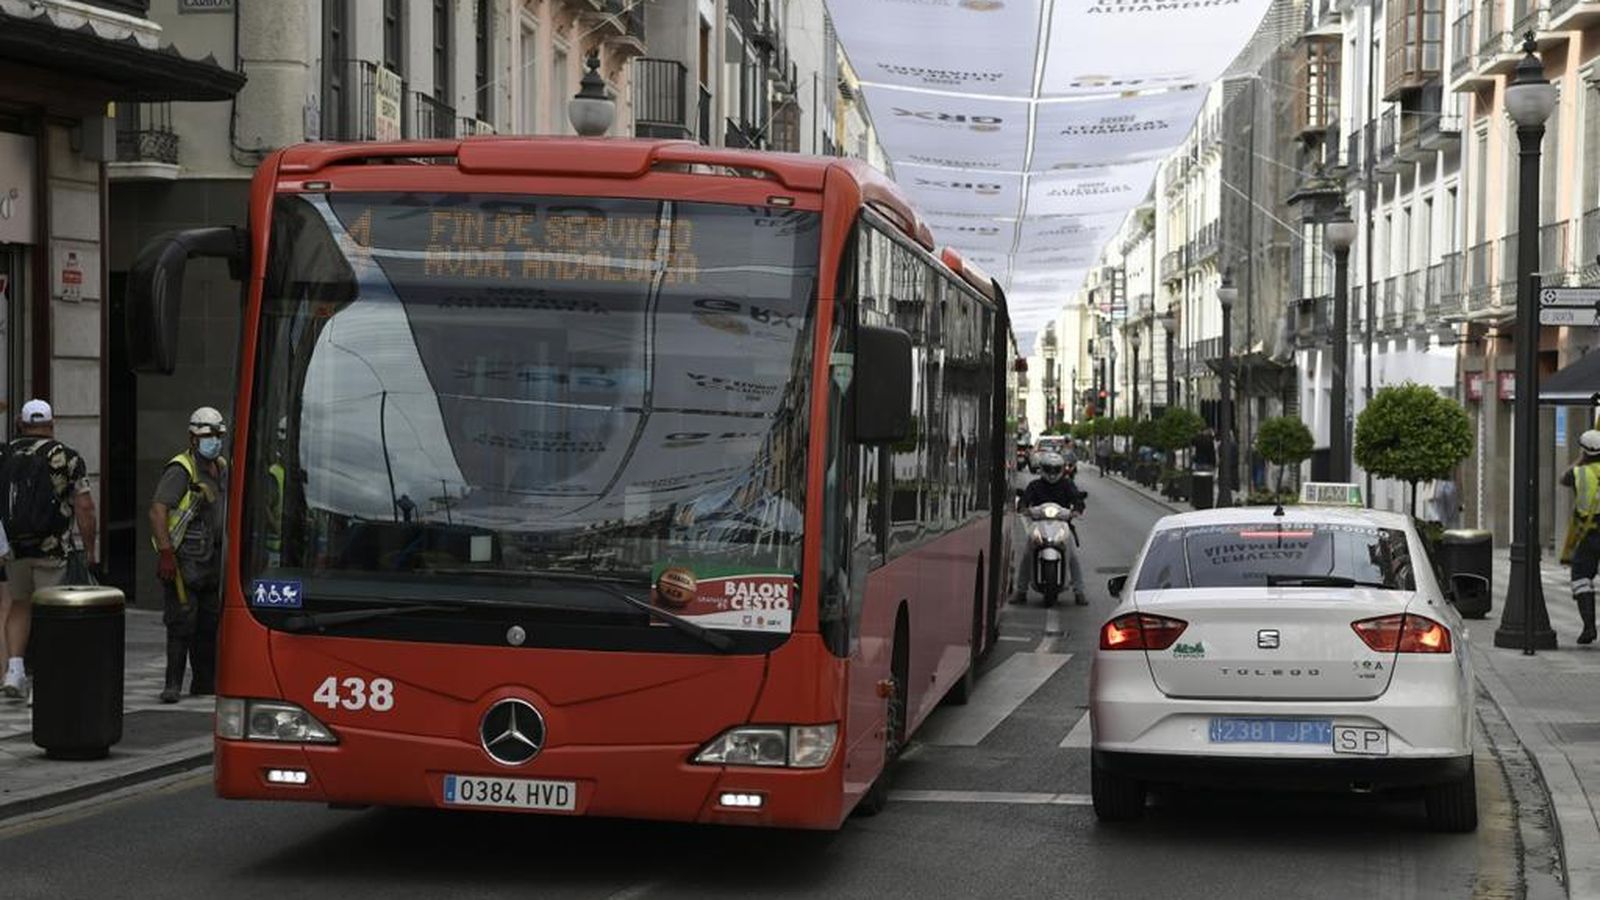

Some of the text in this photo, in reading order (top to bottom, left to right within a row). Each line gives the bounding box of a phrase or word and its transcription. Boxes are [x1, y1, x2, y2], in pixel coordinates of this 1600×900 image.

[431, 209, 485, 245] FIN
[495, 212, 535, 245] DE
[1318, 486, 1348, 502] TAXI
[725, 581, 788, 598] BALON
[731, 597, 790, 610] CESTO
[1219, 667, 1321, 677] TOLEDO
[313, 676, 395, 711] 438
[1223, 719, 1328, 742] 2381 JPY
[1341, 729, 1381, 751] SP
[460, 779, 569, 807] 0384 HVD
